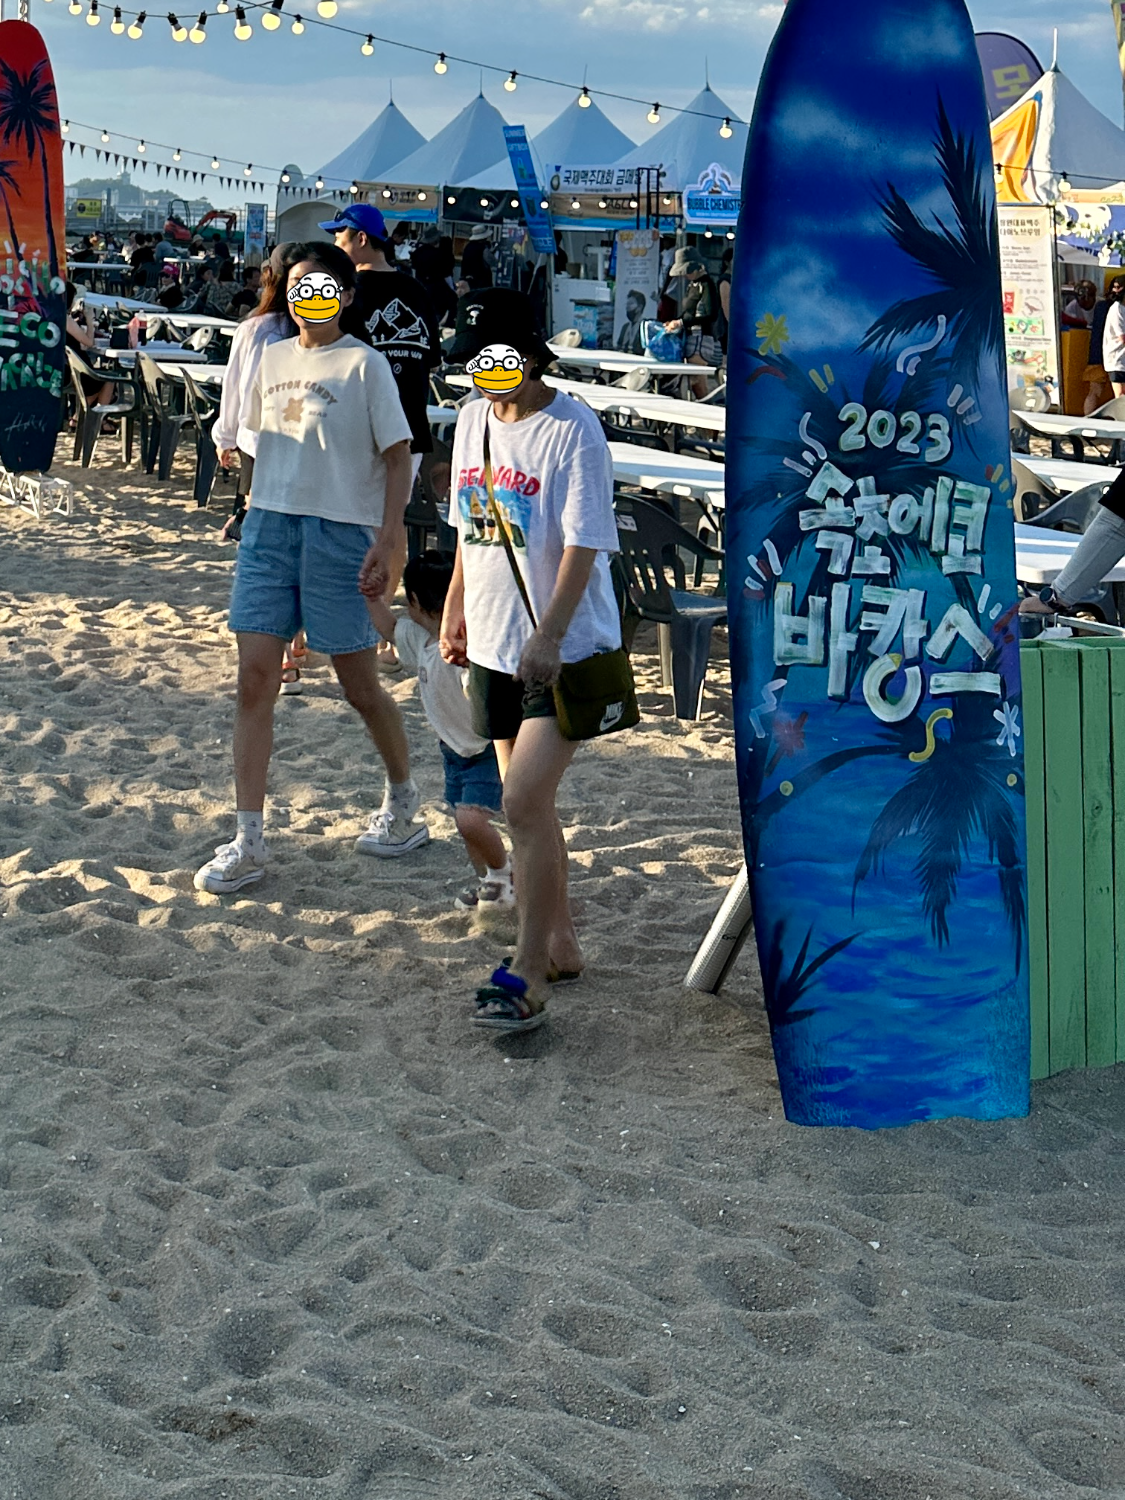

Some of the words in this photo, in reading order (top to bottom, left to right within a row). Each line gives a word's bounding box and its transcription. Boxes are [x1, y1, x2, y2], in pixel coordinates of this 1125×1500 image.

[263, 380, 301, 399] COTTON
[304, 381, 338, 405] CANDY
[838, 402, 952, 463] 2023
[798, 461, 991, 577] 속초에코
[775, 582, 1003, 722] 바캉스
